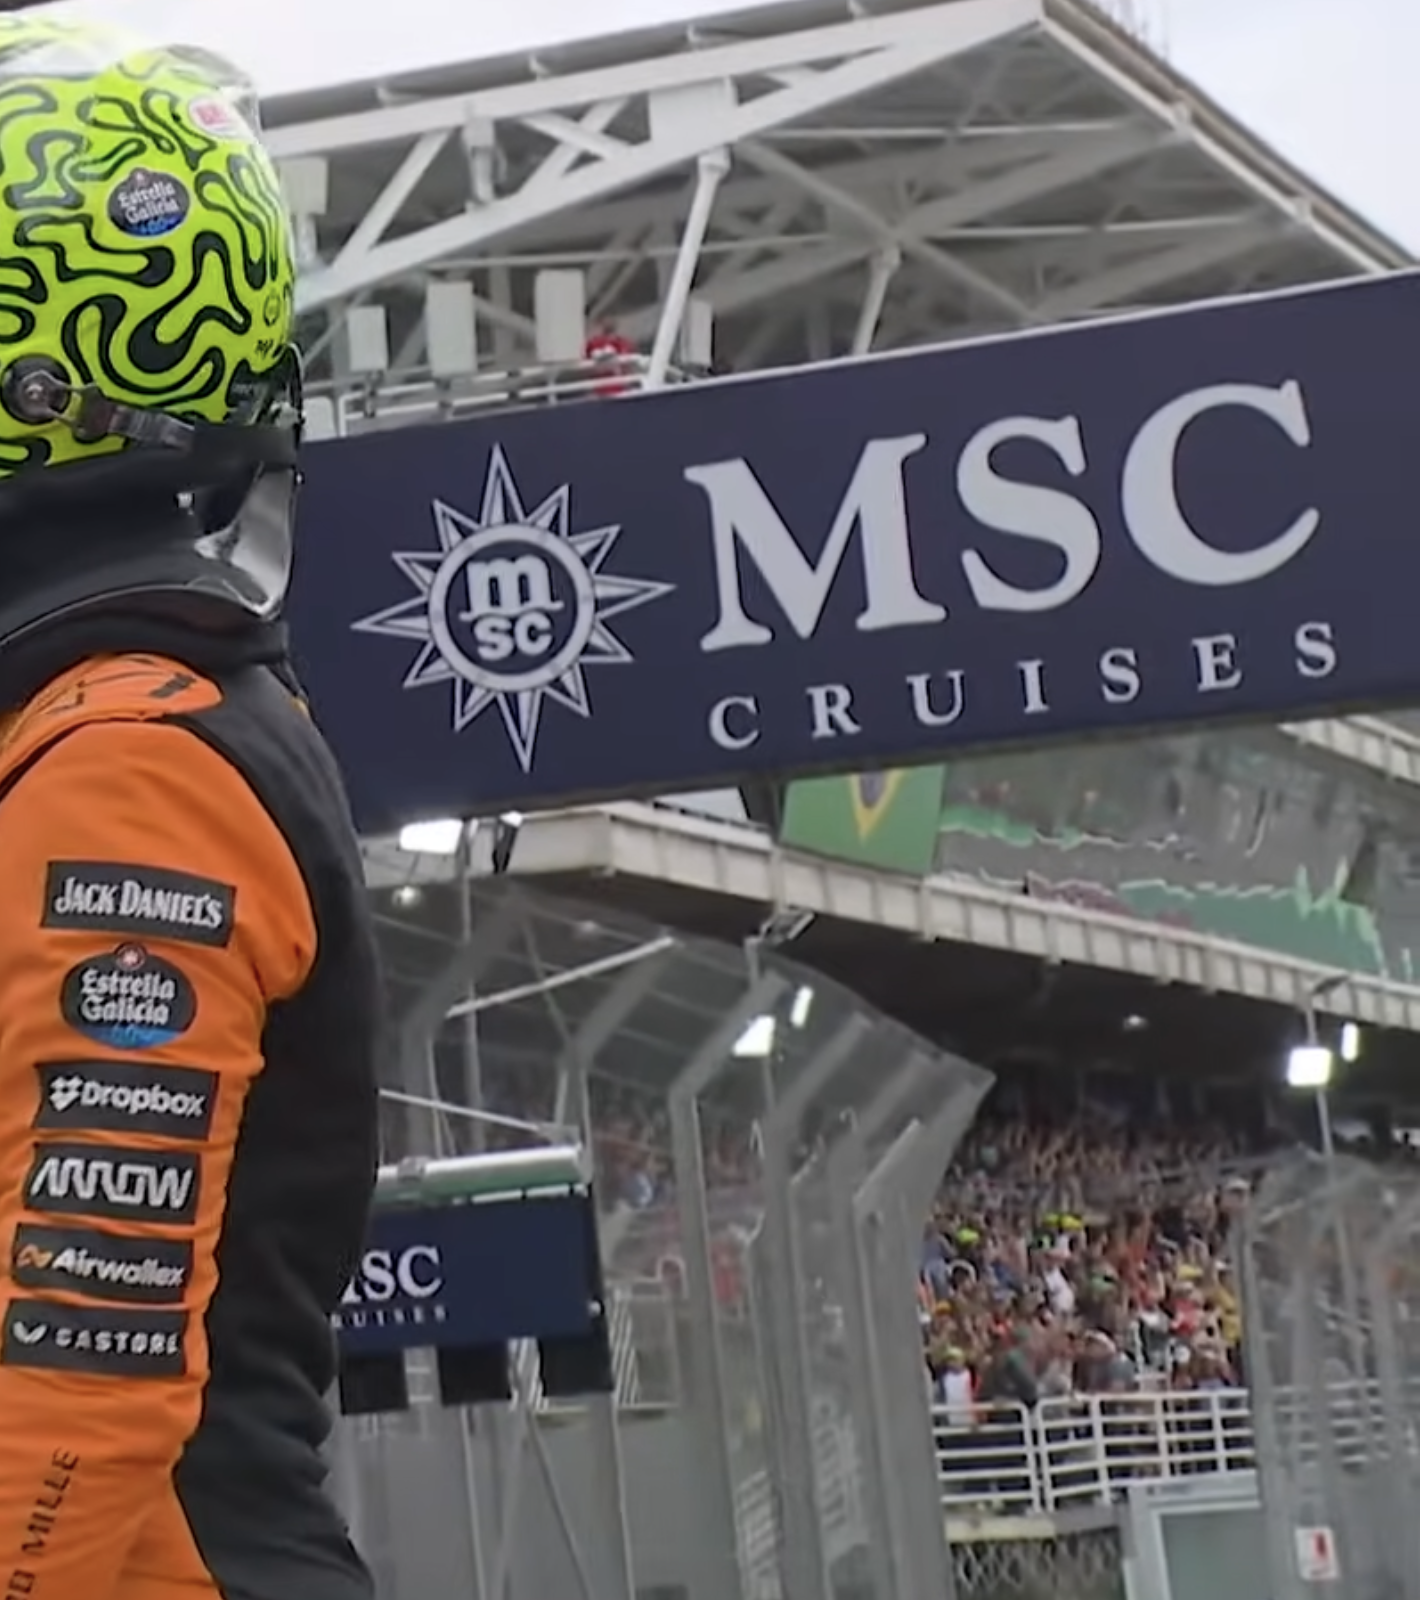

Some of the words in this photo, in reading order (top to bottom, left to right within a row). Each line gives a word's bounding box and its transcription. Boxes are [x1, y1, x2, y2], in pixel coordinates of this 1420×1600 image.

[118, 181, 176, 209] Estrella
[125, 198, 180, 224] Galicia
[684, 379, 1321, 651] MSC
[708, 622, 1337, 749] CRUISES
[55, 876, 120, 914] JACK
[81, 968, 176, 1000] Estrella
[81, 995, 169, 1025] Galicia
[81, 1080, 206, 1118] Dropbox
[30, 1157, 193, 1209] ARROW
[52, 1248, 186, 1287] Airwallex
[55, 1328, 179, 1354] CASTORE
[21, 1446, 79, 1557] MILLE
